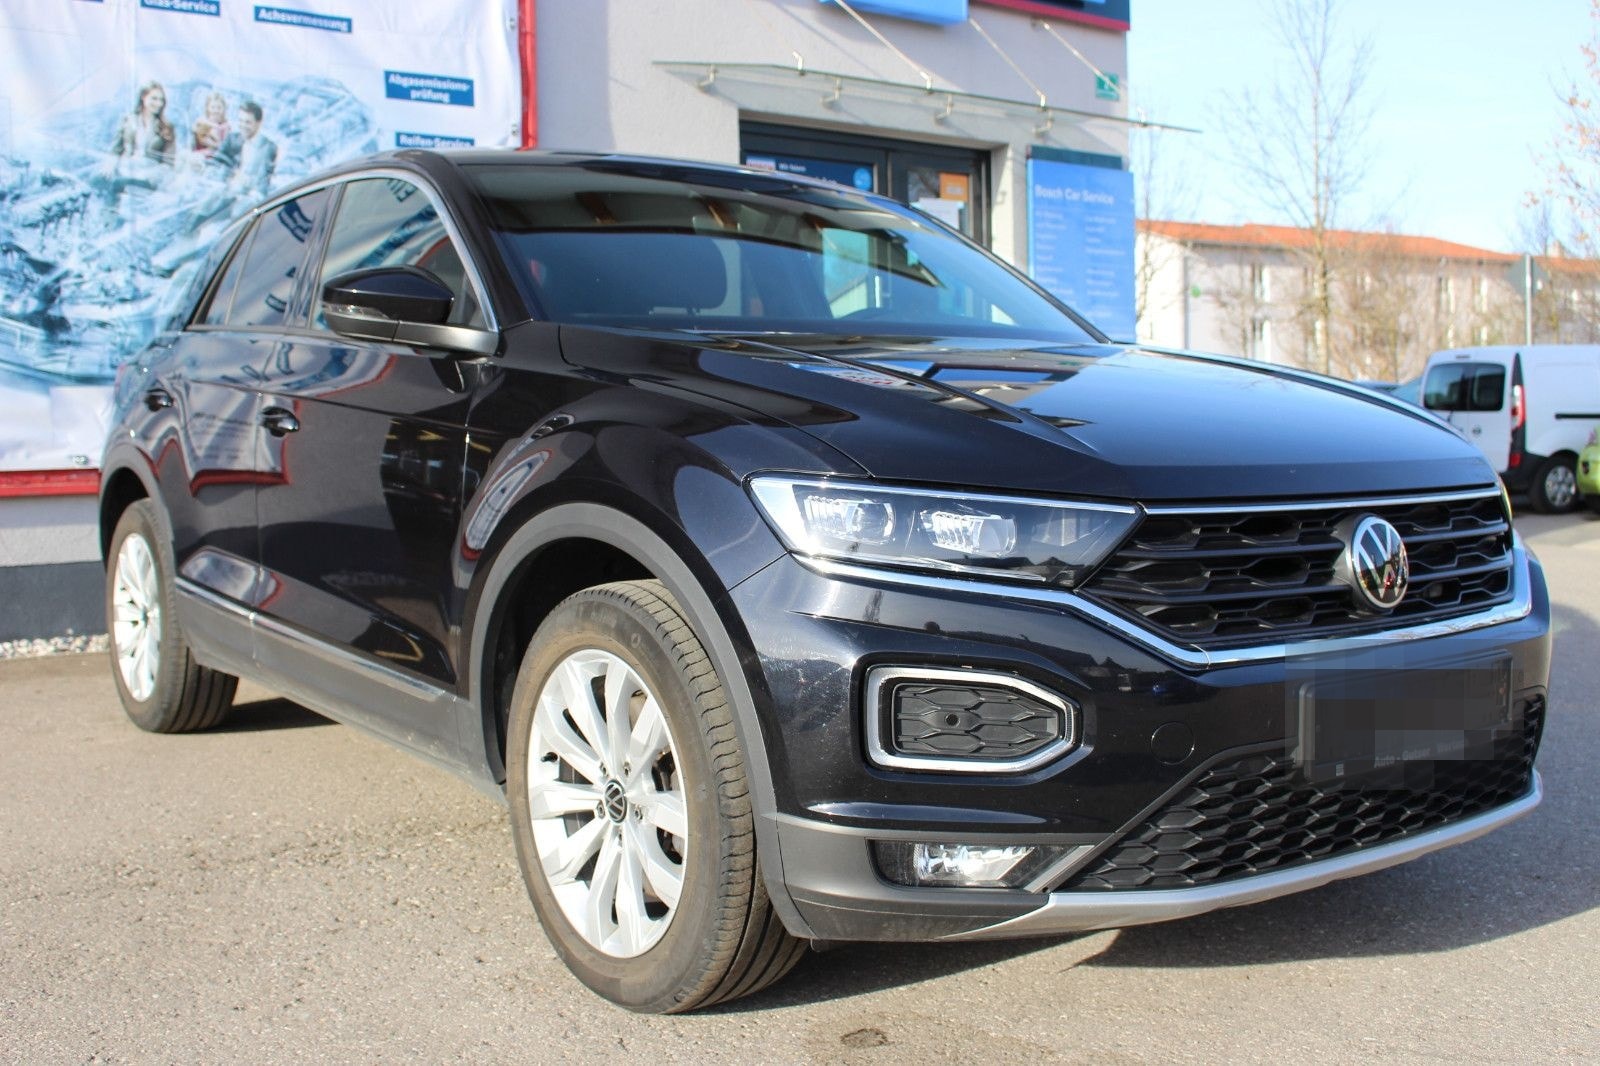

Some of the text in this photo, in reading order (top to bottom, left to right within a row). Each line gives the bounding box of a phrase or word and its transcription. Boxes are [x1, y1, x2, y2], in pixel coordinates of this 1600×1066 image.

[258, 8, 348, 32] Achsvermessung
[388, 73, 471, 92] Abgasemissions-
[410, 89, 450, 103] prüfung
[1065, 187, 1081, 201] Car
[1082, 190, 1115, 205] Service
